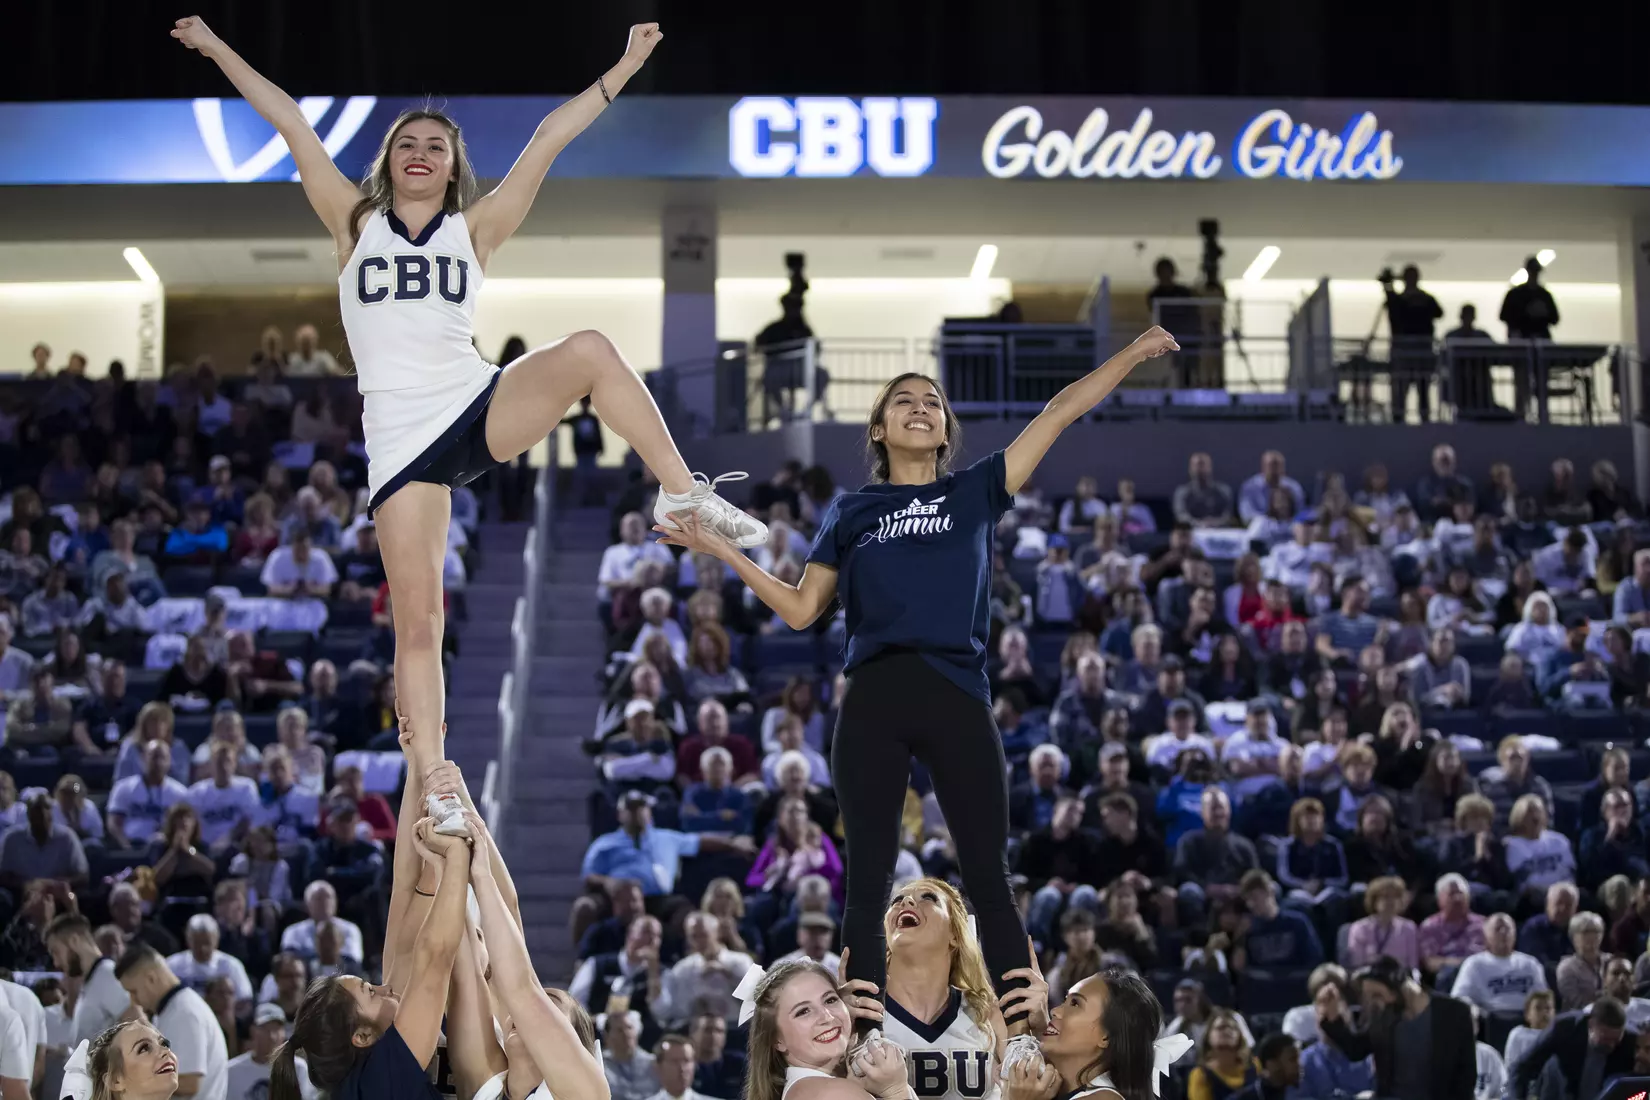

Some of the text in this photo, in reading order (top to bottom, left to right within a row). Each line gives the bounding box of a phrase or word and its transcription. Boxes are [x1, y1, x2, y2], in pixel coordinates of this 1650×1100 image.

[729, 97, 1403, 181] CBU Golden Girls
[356, 253, 469, 308] CBU
[857, 514, 954, 548] Alumni
[893, 504, 939, 520] CHEER
[906, 1048, 990, 1099] BU
